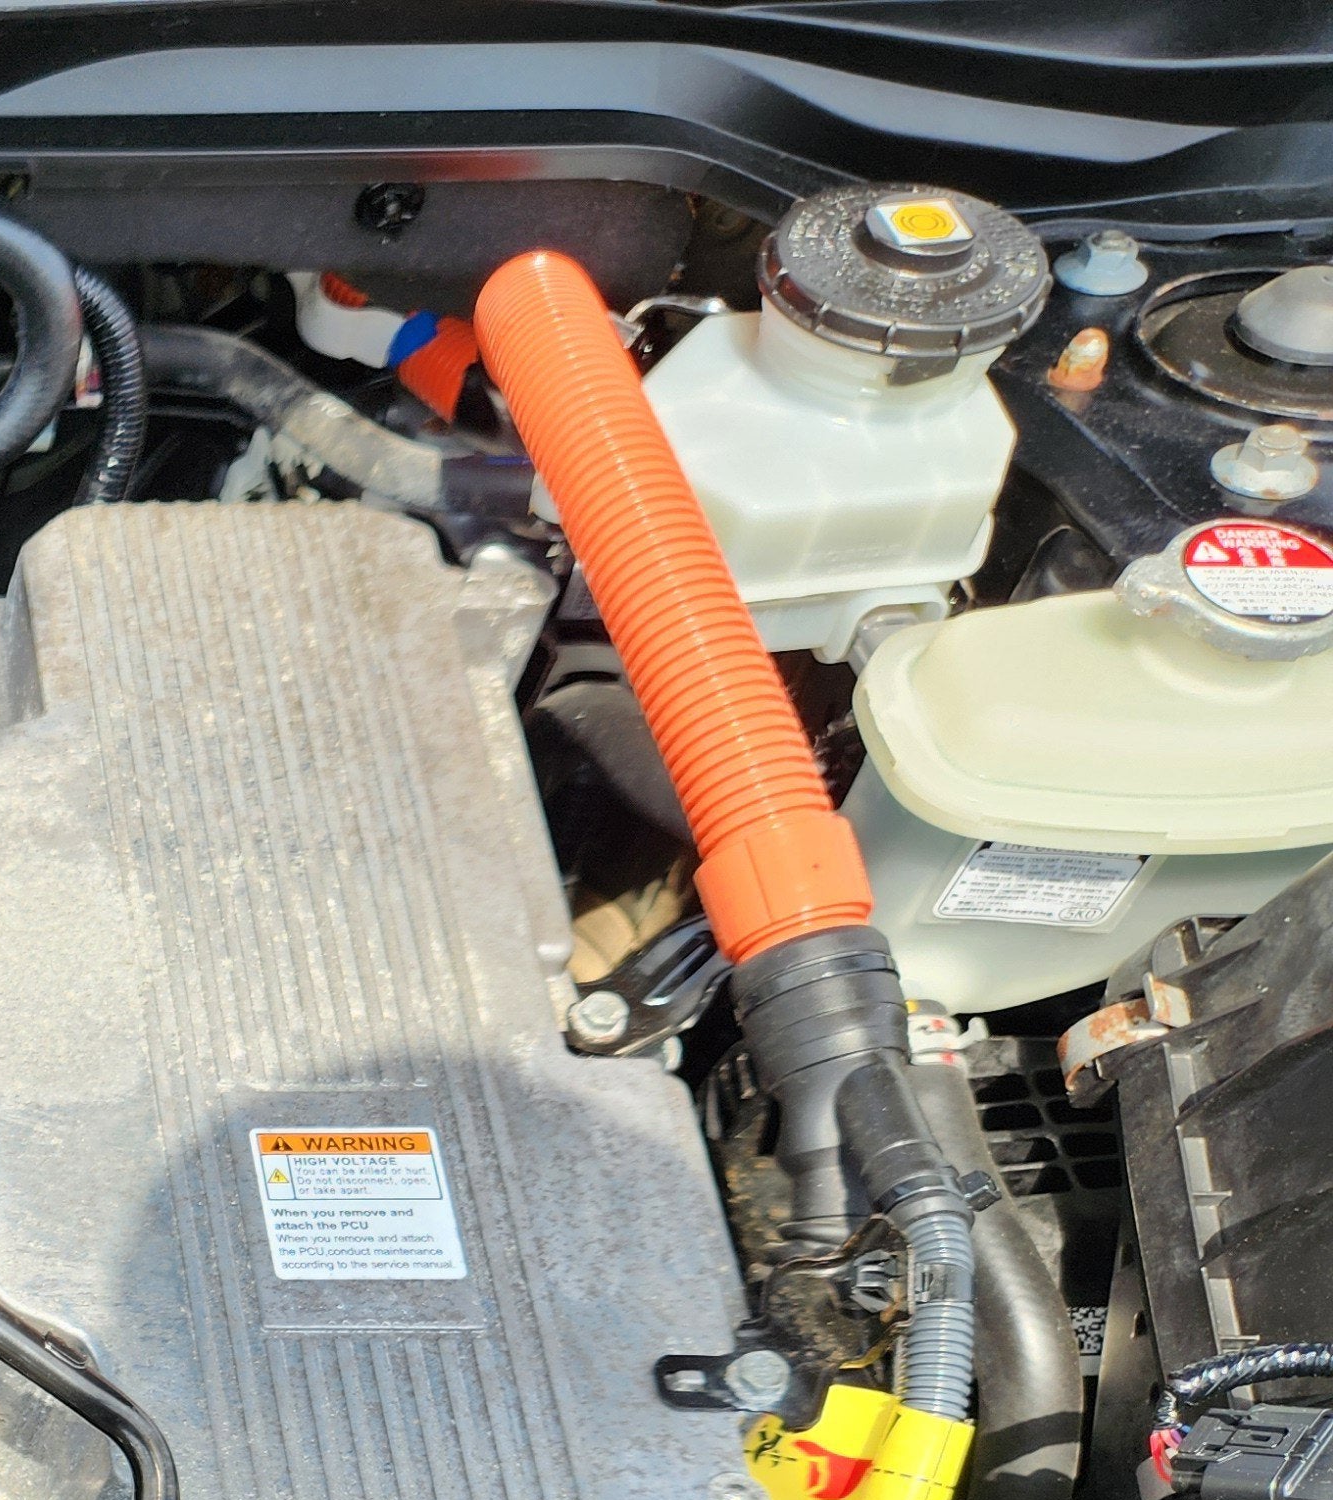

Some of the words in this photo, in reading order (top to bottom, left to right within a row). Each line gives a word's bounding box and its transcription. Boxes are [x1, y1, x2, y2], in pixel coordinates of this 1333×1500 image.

[1214, 529, 1281, 540] DANGER
[301, 1136, 416, 1151] WARNING
[294, 1157, 326, 1166] HIGH
[331, 1157, 398, 1166] VOLTAGE
[295, 1168, 315, 1176] You
[297, 1177, 312, 1185] Do
[315, 1177, 332, 1185] not
[336, 1177, 398, 1186] disconnect,
[313, 1186, 336, 1195] take
[340, 1187, 372, 1196] apart.
[271, 1208, 308, 1217] When
[311, 1208, 335, 1219] you
[339, 1209, 386, 1217] remove
[390, 1208, 414, 1217] and
[275, 1221, 314, 1230] attach
[317, 1221, 337, 1230] the
[341, 1221, 369, 1230] PCU
[276, 1234, 308, 1243] When
[312, 1235, 331, 1244] you
[334, 1235, 374, 1243] remove
[378, 1234, 398, 1243] and
[400, 1234, 434, 1243] attach
[279, 1247, 296, 1256] the
[373, 1247, 443, 1256] maintenance
[282, 1260, 334, 1271] according
[336, 1260, 347, 1269] to
[350, 1260, 367, 1269] the
[371, 1260, 409, 1269] service
